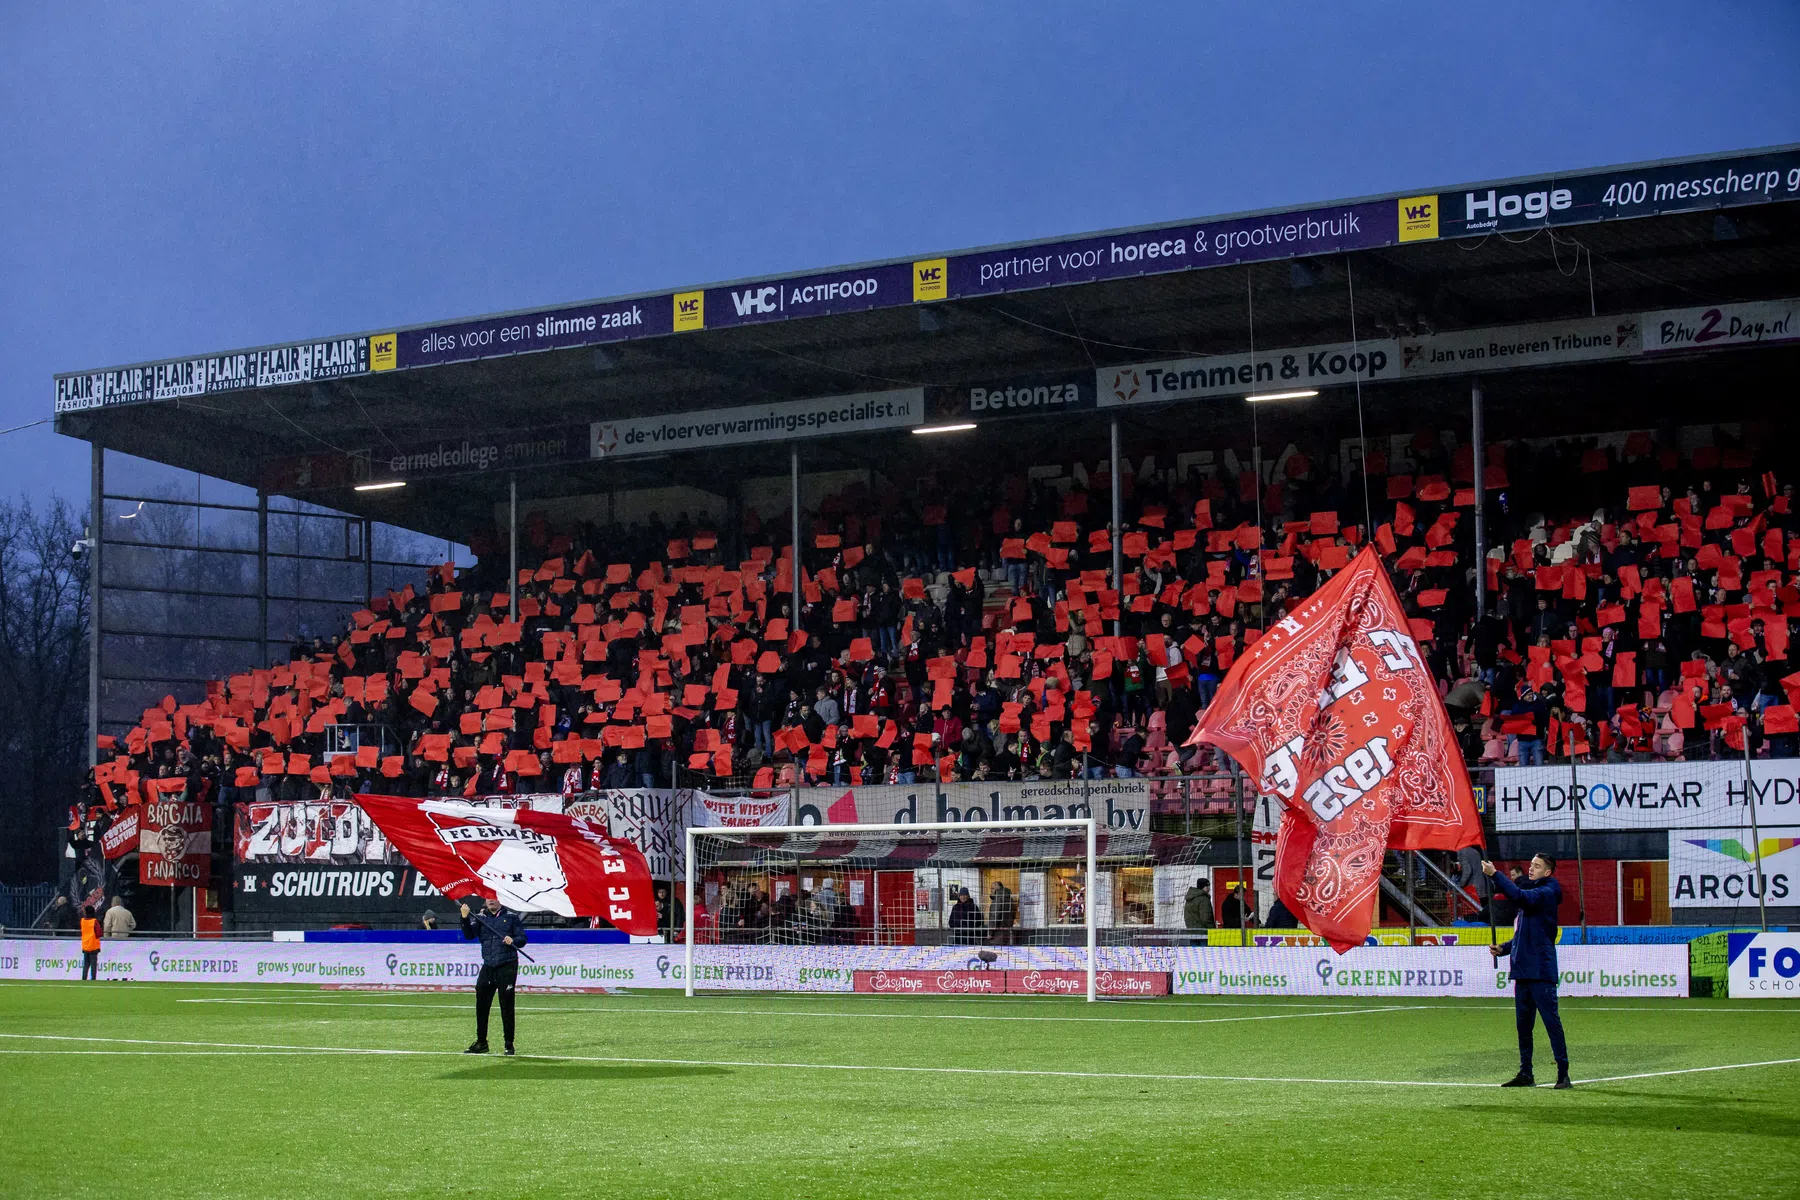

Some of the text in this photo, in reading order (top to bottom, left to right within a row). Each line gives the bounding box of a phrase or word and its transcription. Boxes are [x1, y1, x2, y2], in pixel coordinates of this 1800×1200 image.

[1602, 182, 1646, 207] 400
[1653, 168, 1779, 202] messcherp
[1405, 204, 1431, 220] VHC
[1466, 189, 1572, 220] Hoge
[1466, 220, 1498, 230] Autobedrijf
[980, 212, 1361, 285] partner voor horeca & grootverbruik
[919, 267, 941, 281] VHC
[679, 299, 699, 313] VHC
[731, 278, 878, 316] VHC ACTIFOOD
[421, 305, 642, 354] alles voor een slimme zaak
[314, 339, 356, 368] FLAIR
[375, 341, 392, 354] VHC
[1430, 334, 1612, 363] Jan van Beveren Tribune
[207, 355, 247, 382] FLAIR
[261, 348, 300, 375] FLAIR
[313, 363, 356, 378] FASHION
[1146, 347, 1388, 393] Temmen & Koop
[105, 369, 143, 396] FLAIR
[156, 362, 193, 388] FLAIR
[207, 378, 247, 391] FASHION
[259, 371, 300, 384] FASHION
[58, 377, 93, 402] FLAIR
[105, 392, 143, 404] FASHION
[156, 385, 193, 398] FASHION
[970, 382, 1079, 412] Betonza
[57, 399, 93, 410] FASHION
[625, 401, 911, 445] de-vloerverwarmingsspecialist.nl
[390, 438, 567, 471] carmelcollege emmen
[1021, 781, 1146, 799] gereedschappenfabriek
[1501, 780, 1703, 812] HYDROWEAR
[1726, 777, 1800, 806] HYD
[703, 799, 779, 816] WITTE WIEVEN
[938, 791, 1093, 836] holman
[1106, 798, 1147, 831] bv
[448, 828, 472, 839] FC
[721, 816, 760, 827] EMMEN
[270, 871, 395, 897] SCHUTRUPS
[1674, 873, 1789, 900] ARCUS
[608, 887, 632, 920] FC
[1703, 952, 1728, 964] Emm
[35, 957, 64, 972] grows
[66, 958, 84, 972] you
[97, 959, 133, 972] usiness
[161, 959, 239, 973] GREENPRIDE
[257, 961, 289, 976] grows
[291, 960, 316, 977] your
[318, 961, 366, 977] business
[399, 962, 480, 977] GREENPRID
[518, 964, 547, 976] rows
[549, 964, 578, 980] your
[580, 963, 634, 980] business
[672, 965, 774, 980] GEENPRIDE
[799, 967, 841, 983] grows
[1179, 969, 1214, 989] your
[1219, 970, 1288, 987] business
[1336, 969, 1464, 987] GREENPRIDE
[1600, 969, 1677, 988] business
[874, 973, 923, 992] EasyToys
[941, 973, 992, 992] EasyToys
[1027, 973, 1079, 992] EasyToys
[1749, 980, 1800, 991] SCHO
